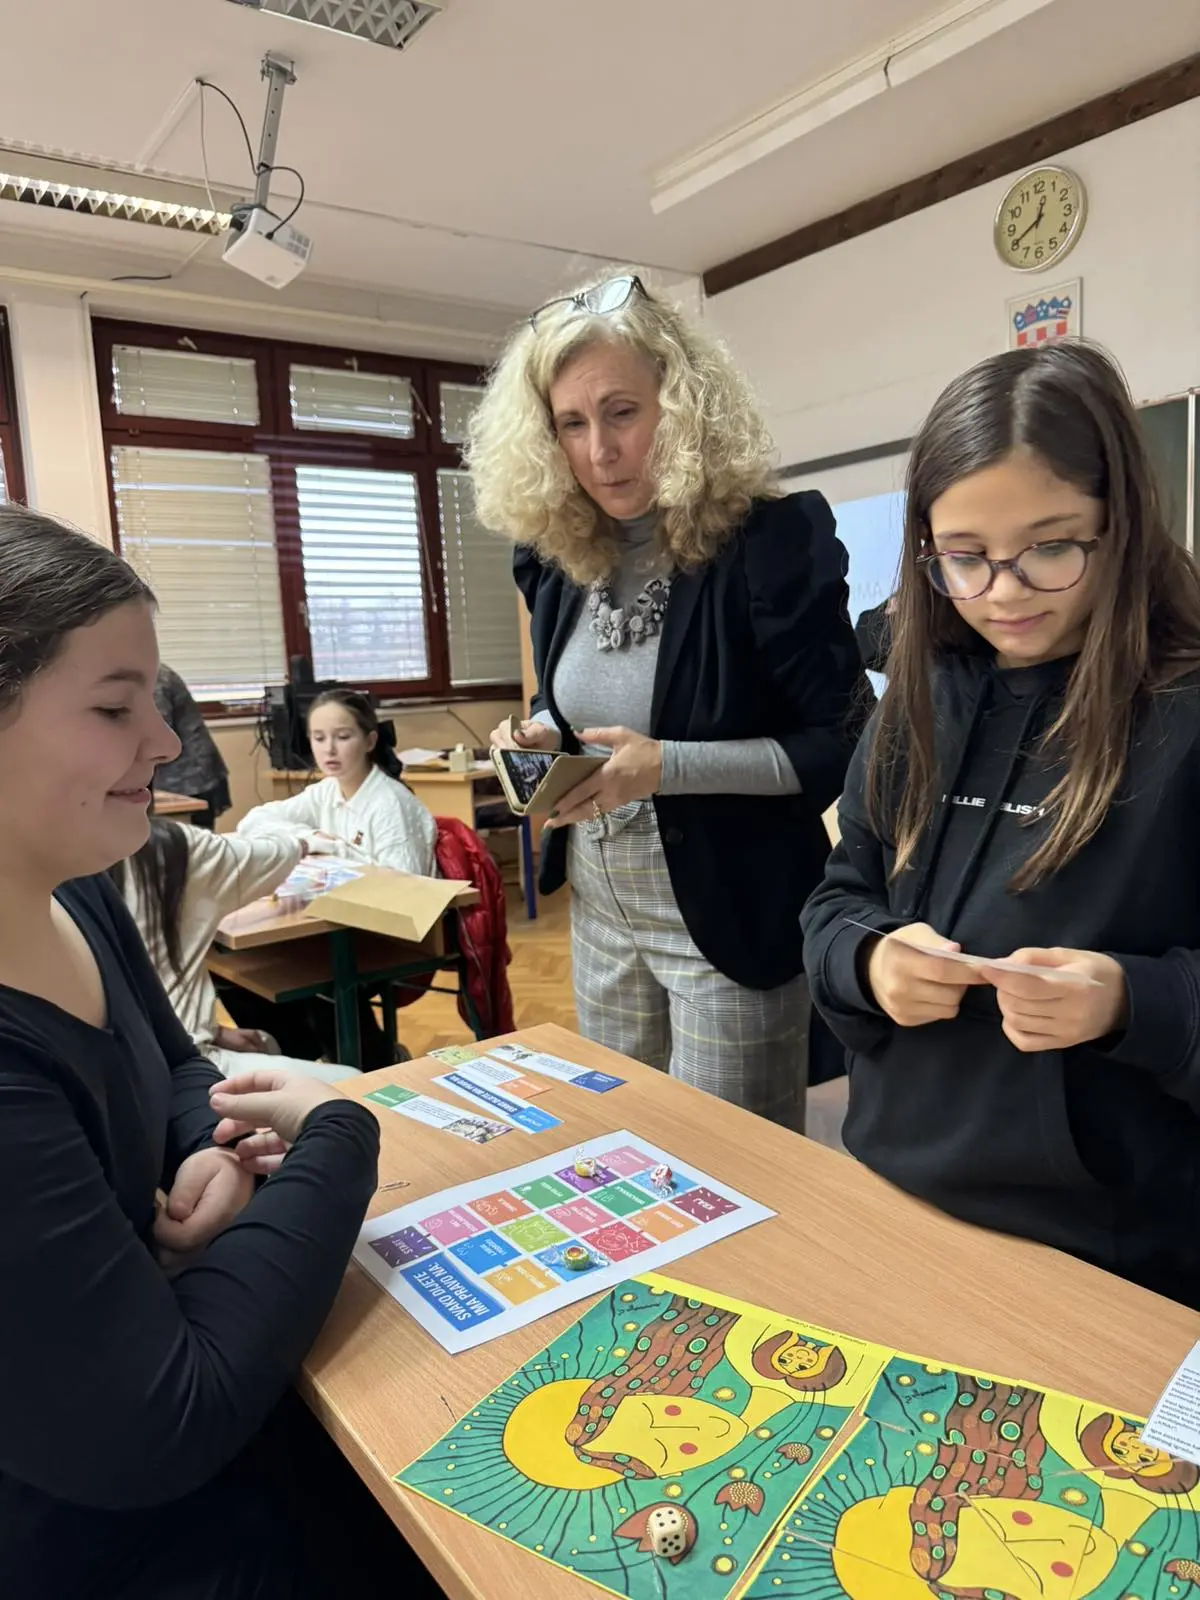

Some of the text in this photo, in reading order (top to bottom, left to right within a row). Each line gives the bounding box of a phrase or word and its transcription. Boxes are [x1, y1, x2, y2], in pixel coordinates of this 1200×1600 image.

[1033, 180, 1045, 194] 12
[1020, 190, 1030, 204] 11
[1059, 188, 1069, 202] 2
[1008, 206, 1022, 220] 10
[1063, 203, 1073, 217] 3
[1007, 224, 1016, 237] 9
[1059, 222, 1068, 233] 4
[1011, 240, 1020, 252] 8
[1049, 237, 1058, 250] 5
[1022, 246, 1031, 259] 7
[1034, 246, 1044, 259] 6
[440, 1274, 470, 1300] PRAVO
[412, 1271, 472, 1321] SVAKO DIJETE
[465, 1293, 490, 1316] IMA
